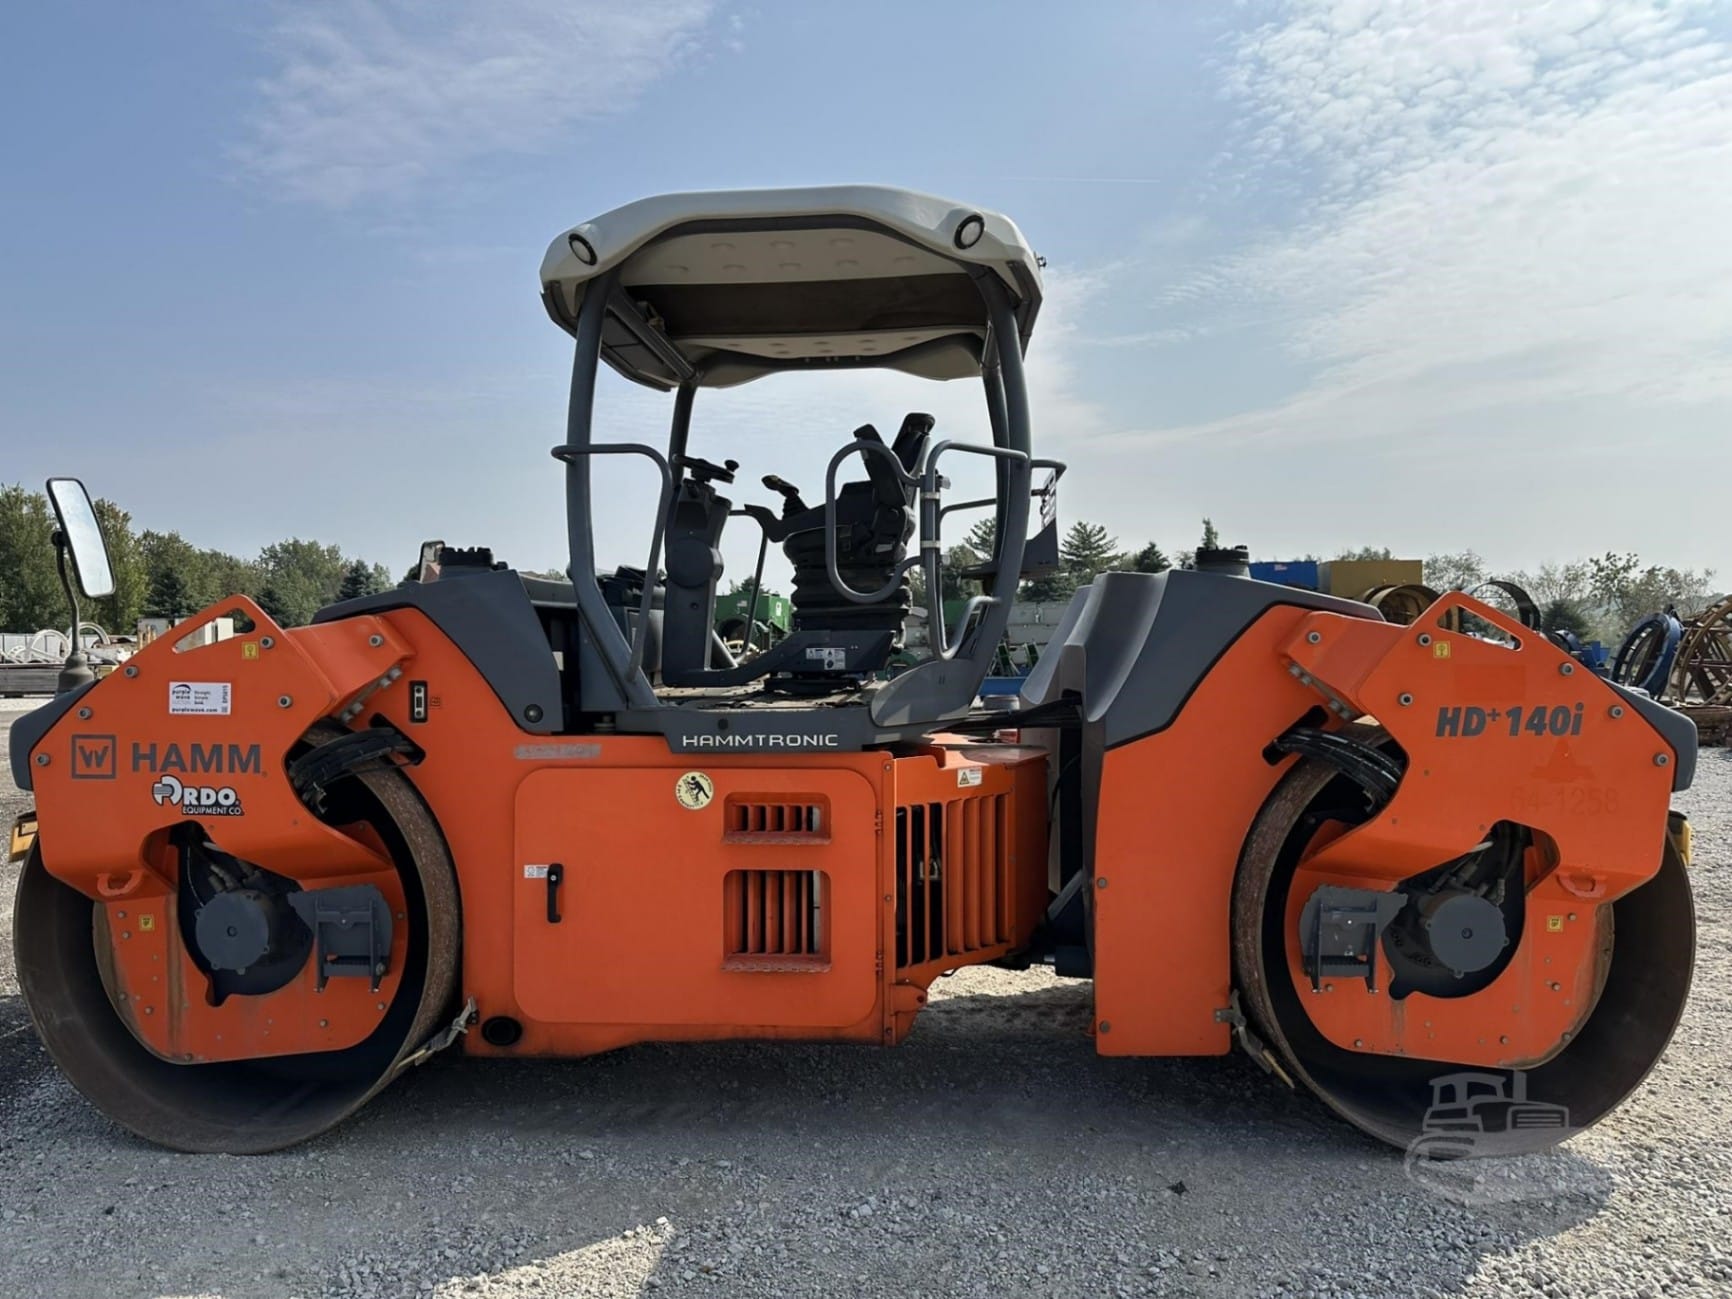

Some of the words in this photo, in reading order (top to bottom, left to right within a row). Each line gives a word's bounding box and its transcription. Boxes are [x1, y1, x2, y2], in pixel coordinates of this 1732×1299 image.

[1505, 702, 1584, 737] 140i
[682, 734, 839, 747] HAMMTRONIC
[131, 742, 262, 774] HAMM
[182, 806, 227, 815] EQUIPMENT
